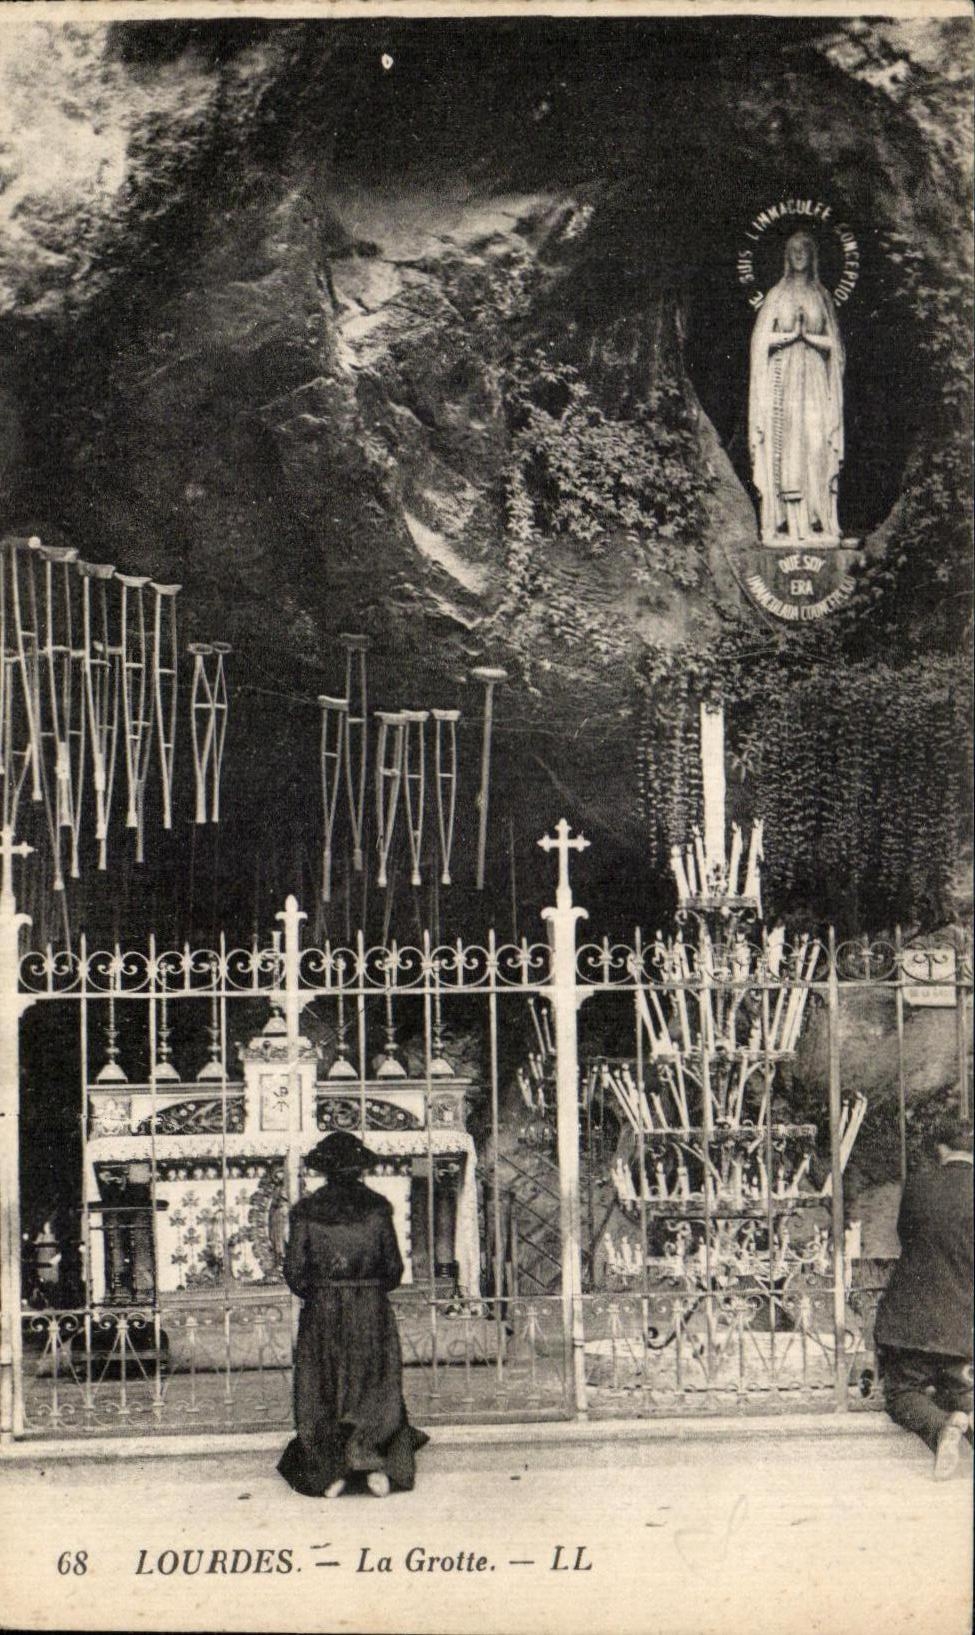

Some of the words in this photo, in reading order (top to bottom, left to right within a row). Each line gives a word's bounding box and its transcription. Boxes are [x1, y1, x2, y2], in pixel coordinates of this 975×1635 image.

[736, 249, 755, 284] SUIS
[778, 554, 801, 574] QUE
[803, 554, 827, 573] SOY
[790, 579, 814, 596] ERA
